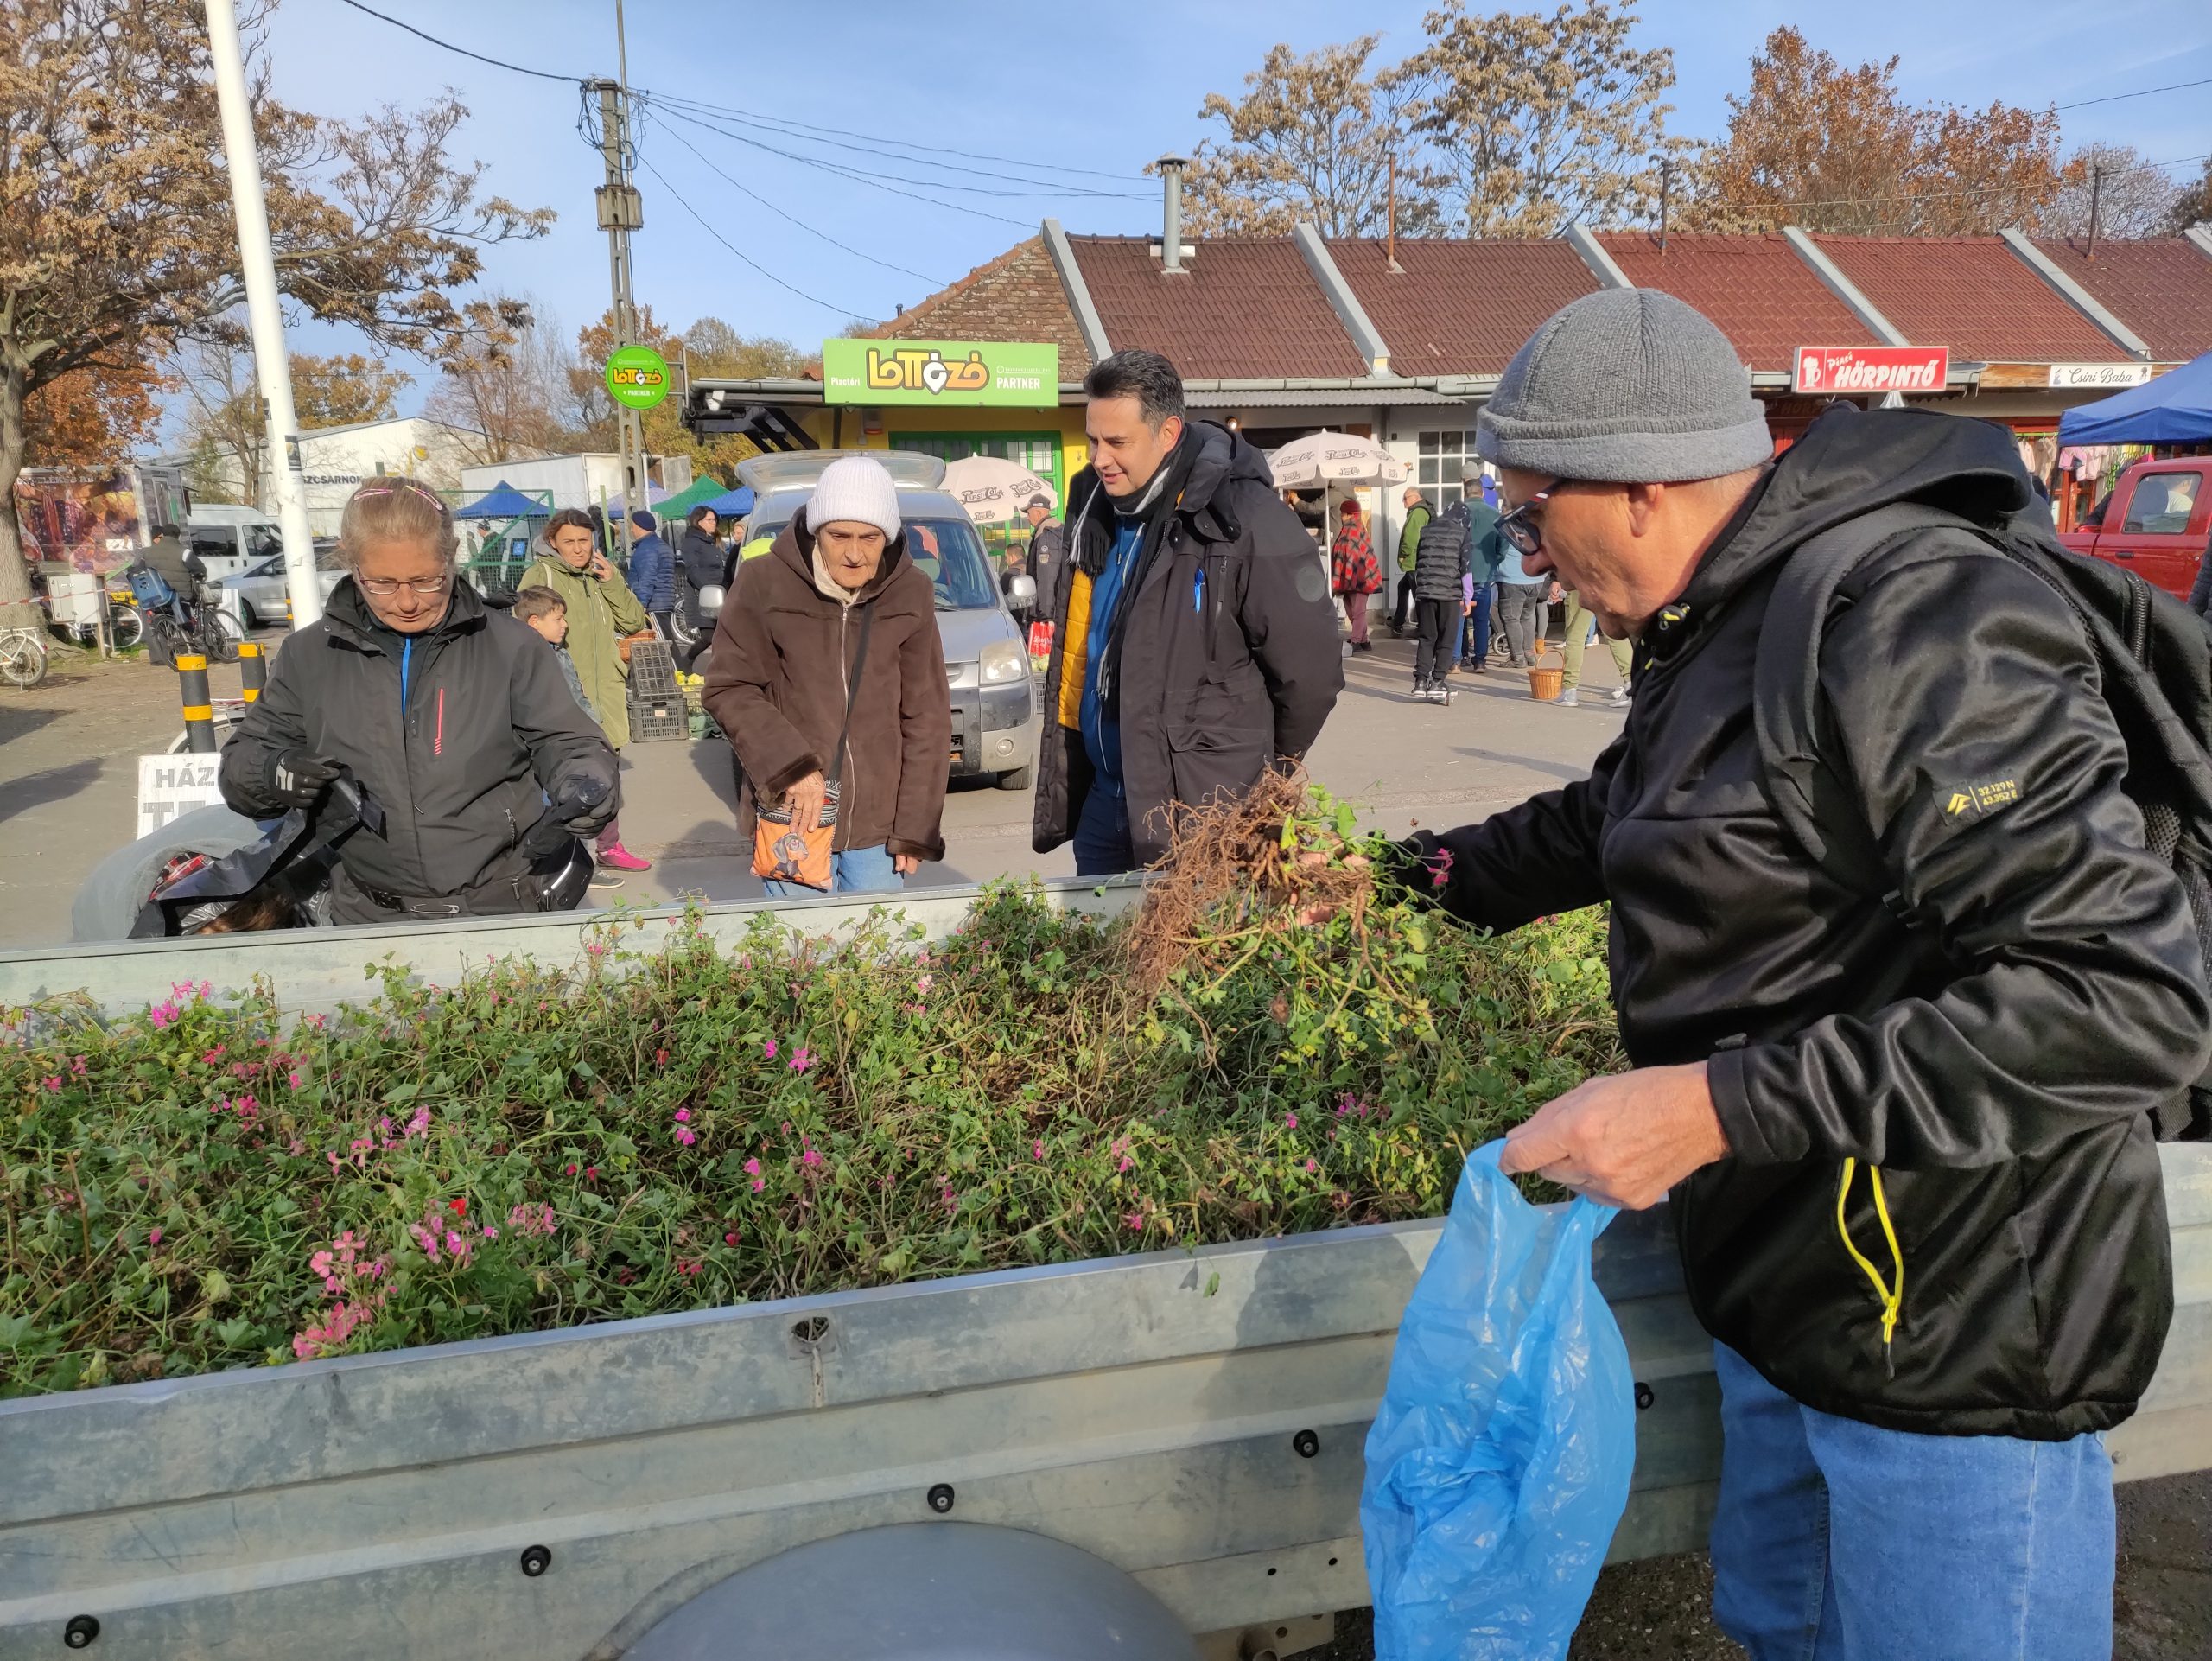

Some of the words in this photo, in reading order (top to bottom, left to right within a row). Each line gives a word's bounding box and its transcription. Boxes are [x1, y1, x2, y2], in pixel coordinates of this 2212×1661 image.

[996, 377, 1040, 389] PARTNER
[1834, 360, 1940, 389] HÖRPINTŐ
[2069, 367, 2097, 384] Csini
[2100, 367, 2132, 384] Baba
[156, 763, 220, 788] HÁZ
